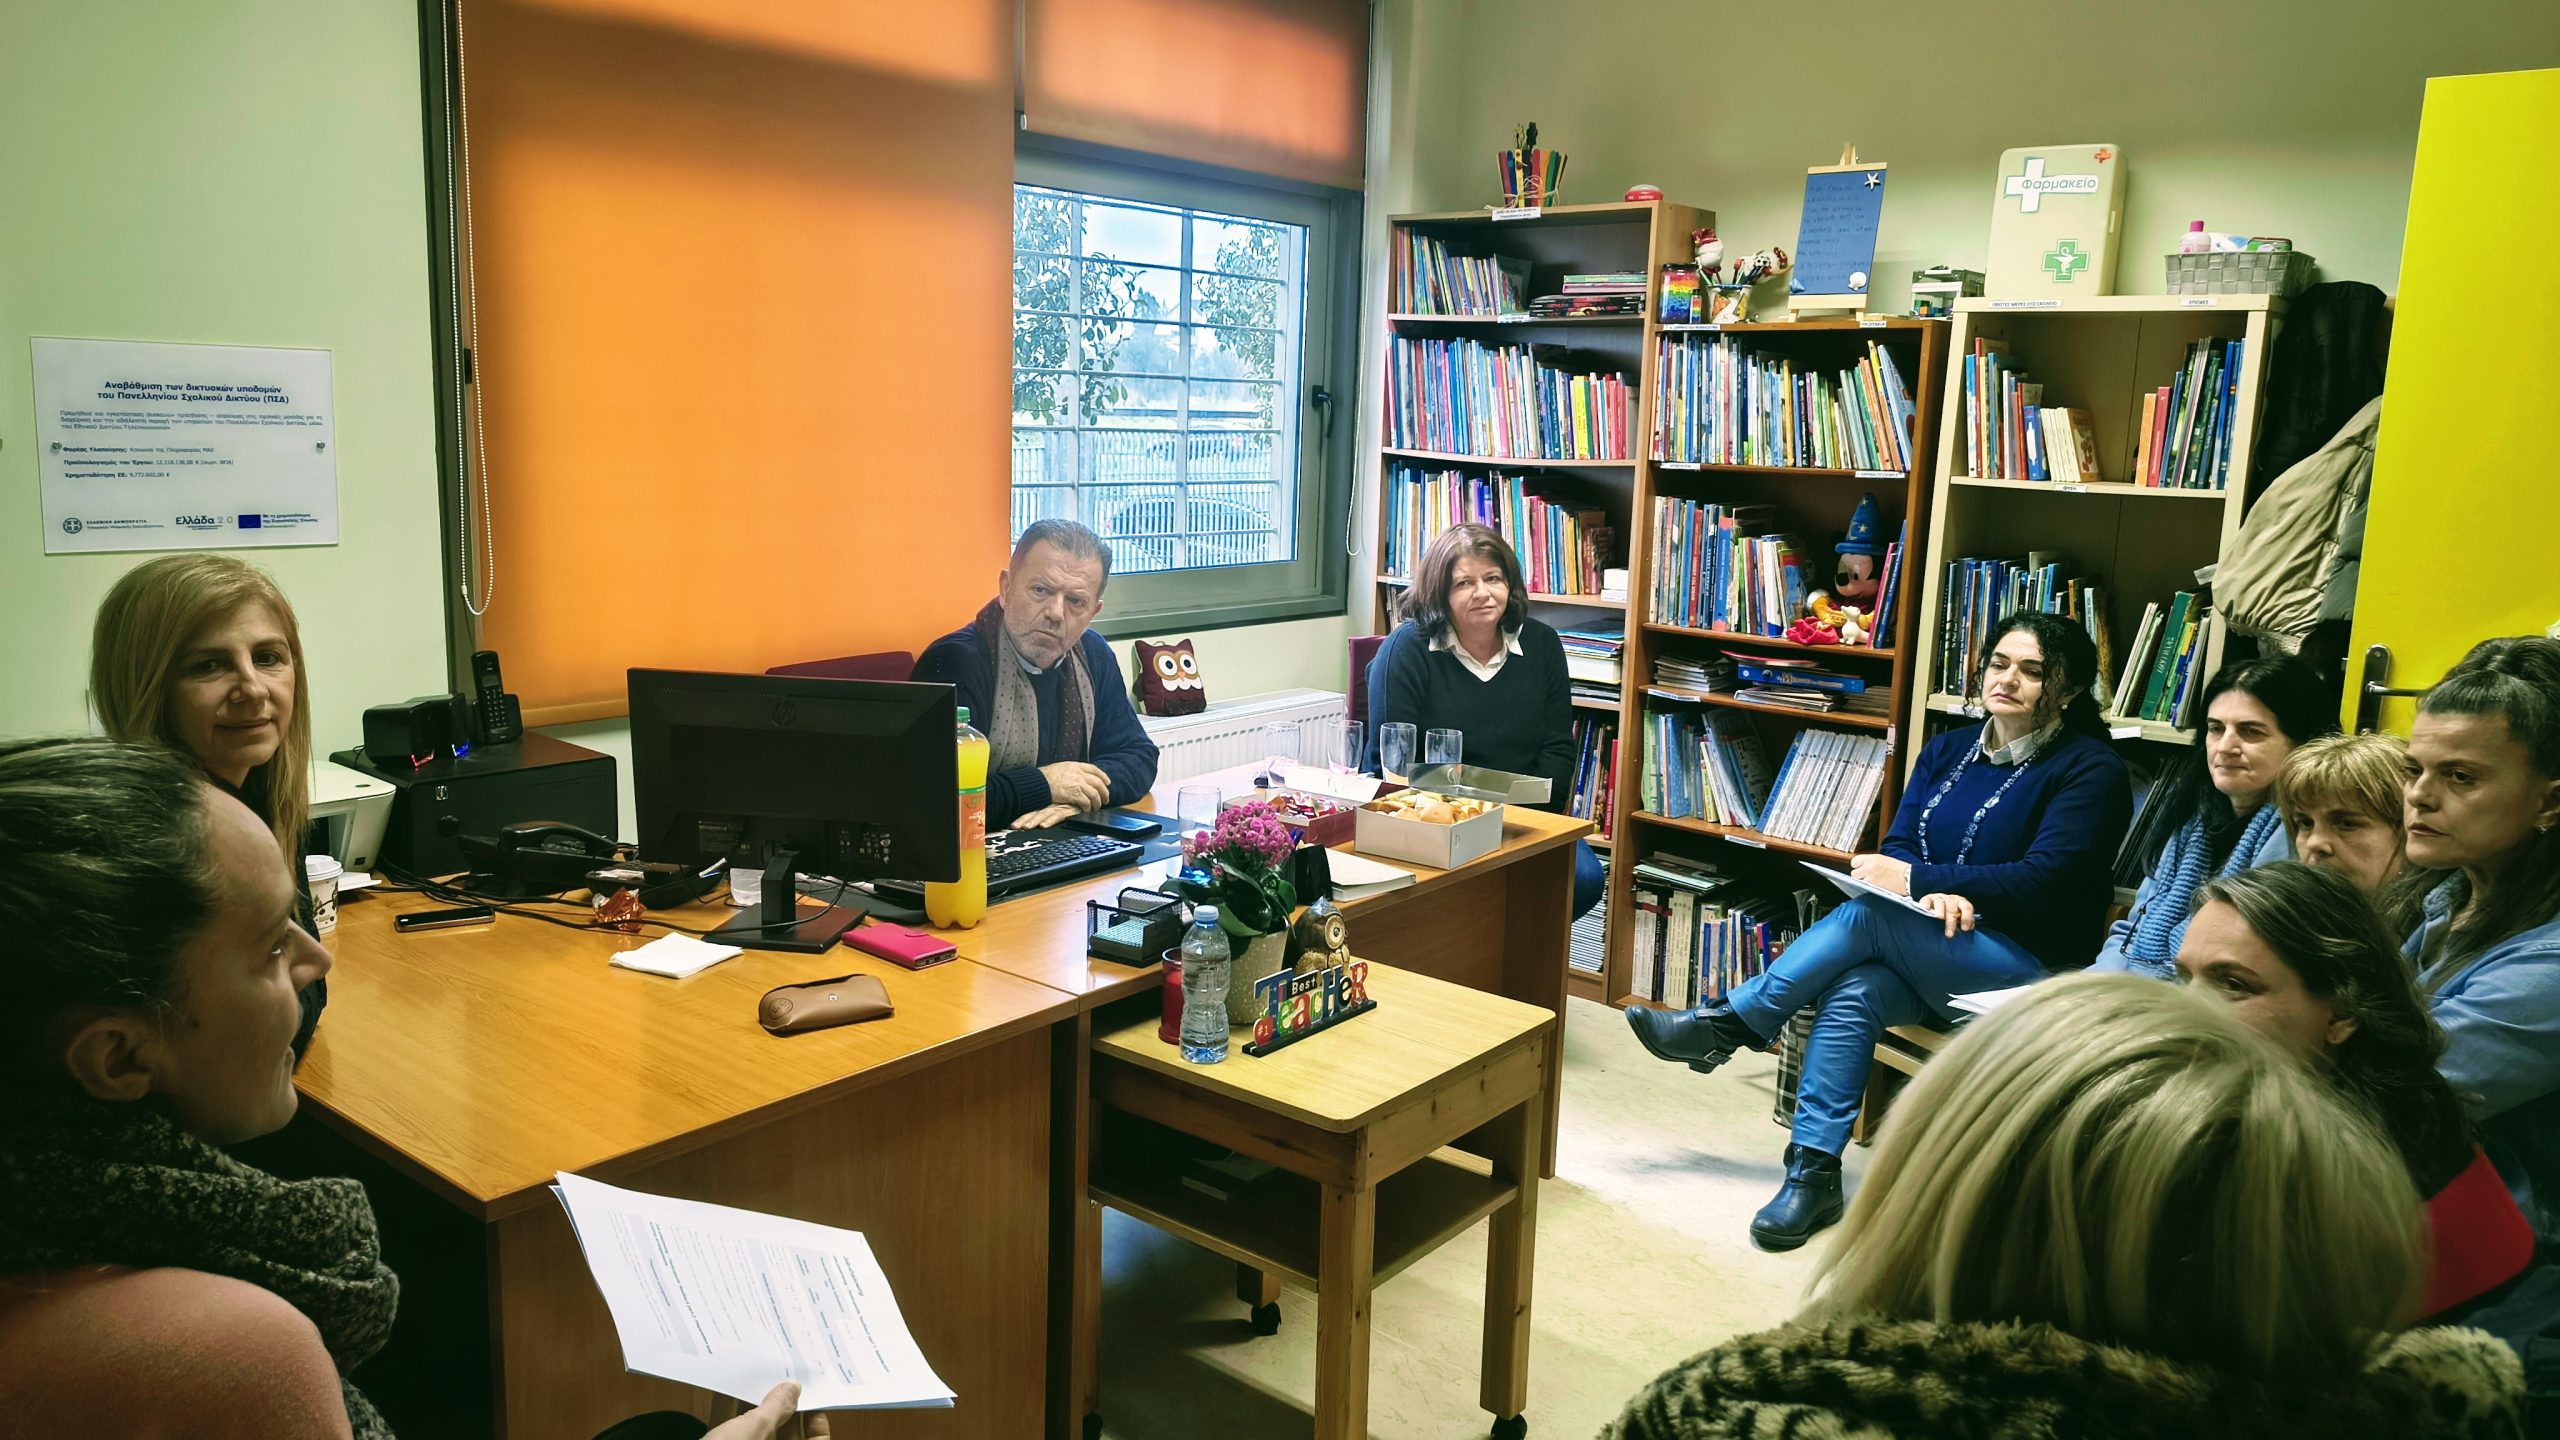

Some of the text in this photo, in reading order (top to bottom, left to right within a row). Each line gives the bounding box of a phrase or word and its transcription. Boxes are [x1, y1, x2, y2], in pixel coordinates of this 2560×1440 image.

[2021, 177, 2097, 191] Φαρμακείο
[104, 381, 282, 394] Αναβάθμιση των δικτυακών υποδομών
[97, 391, 289, 404] του Πανελληνίου Σχολικού Δικτύου (ΠΣΔ)
[175, 515, 215, 525] Ελλάδα
[1291, 976, 1317, 996] Best
